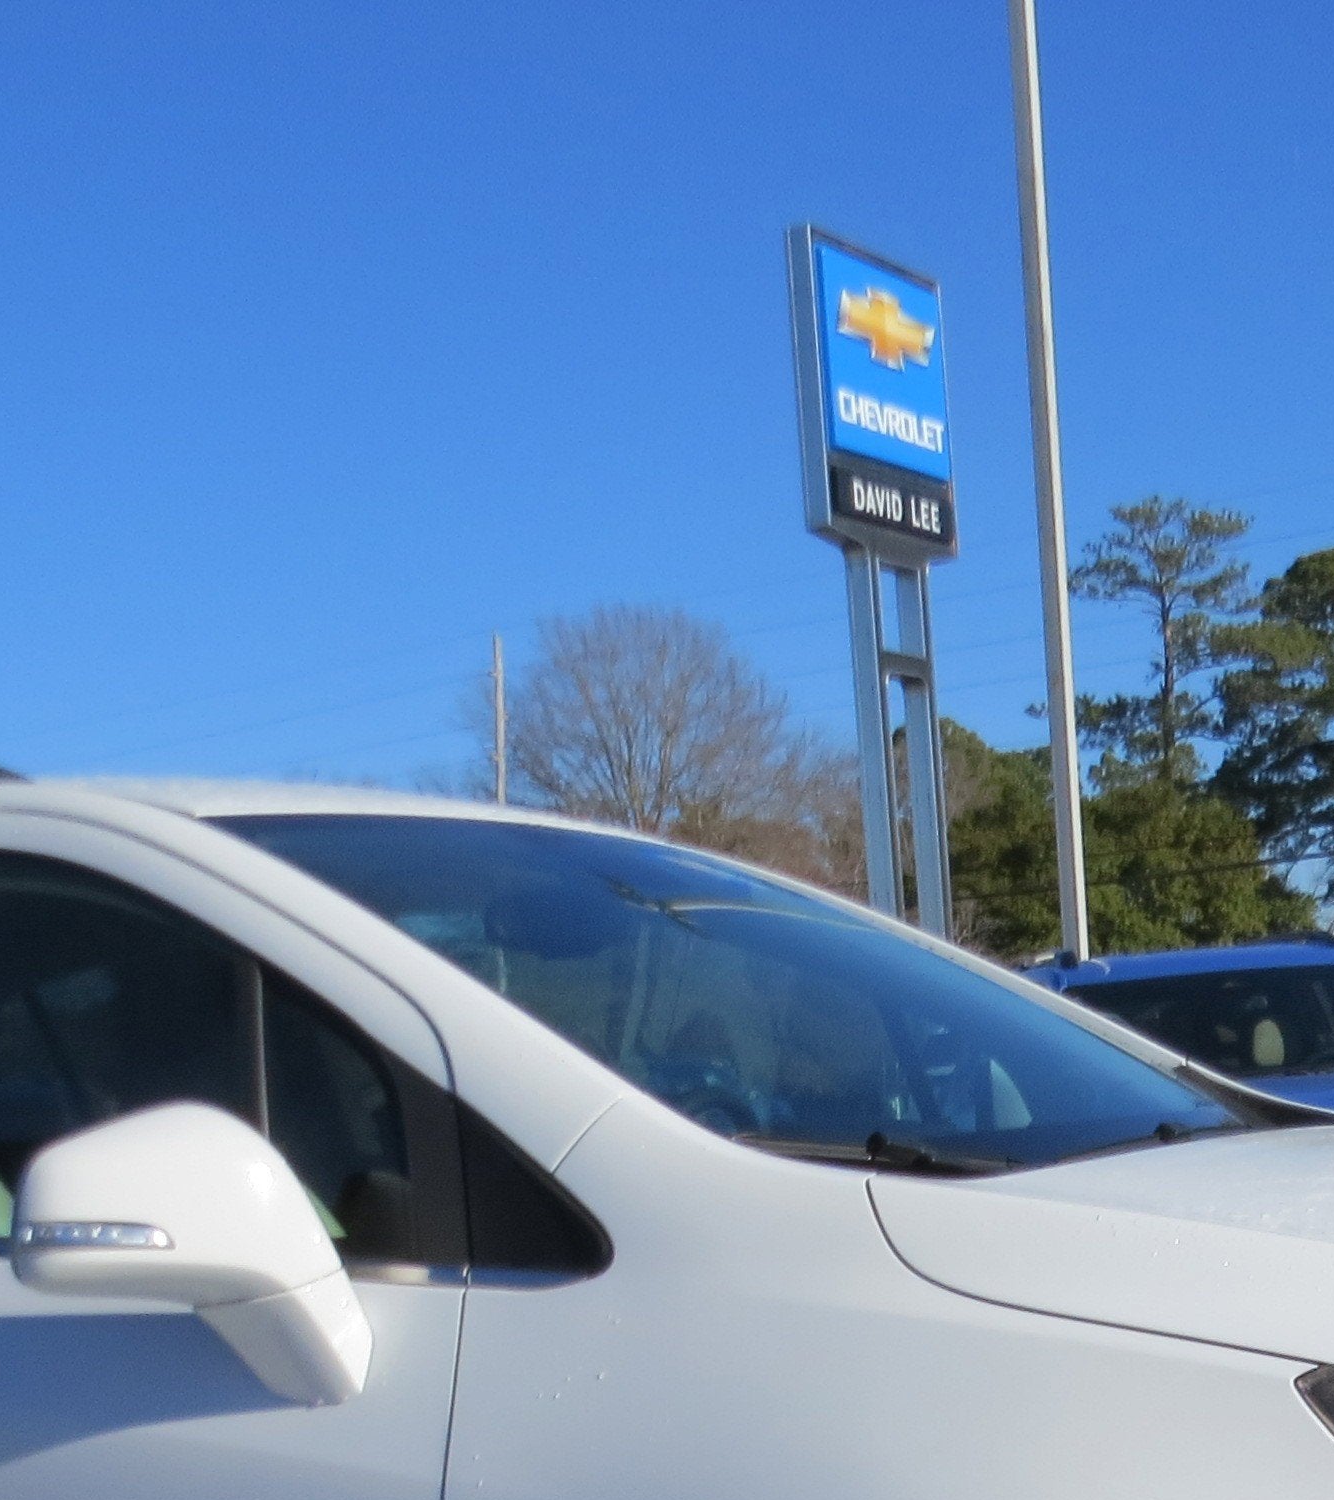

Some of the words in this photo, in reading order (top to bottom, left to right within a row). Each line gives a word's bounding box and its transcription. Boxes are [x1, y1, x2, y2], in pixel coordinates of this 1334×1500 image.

[838, 389, 944, 454] CHEVROLET
[853, 478, 903, 523] DAVID
[910, 496, 941, 534] LEE
